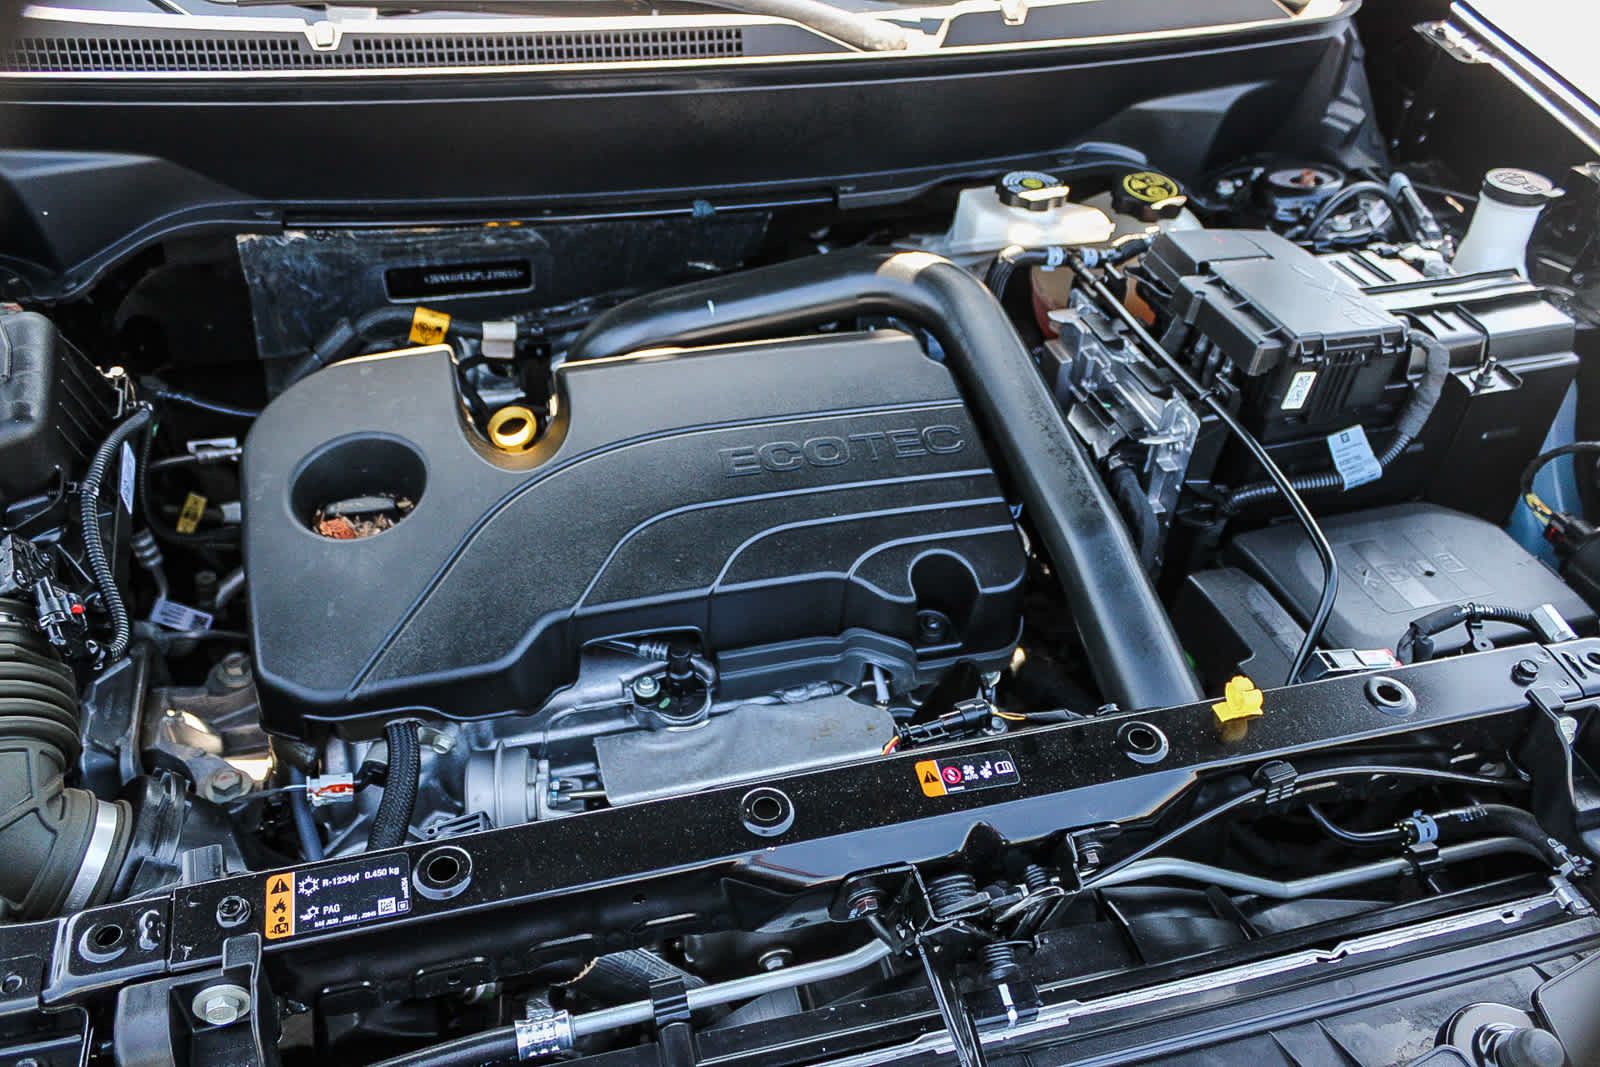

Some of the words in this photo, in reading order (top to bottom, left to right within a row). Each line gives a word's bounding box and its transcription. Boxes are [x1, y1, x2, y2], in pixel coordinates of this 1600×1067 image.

[719, 424, 965, 478] ECOTEC
[364, 868, 387, 880] 0.450
[388, 867, 400, 876] kg
[322, 904, 340, 915] PAG
